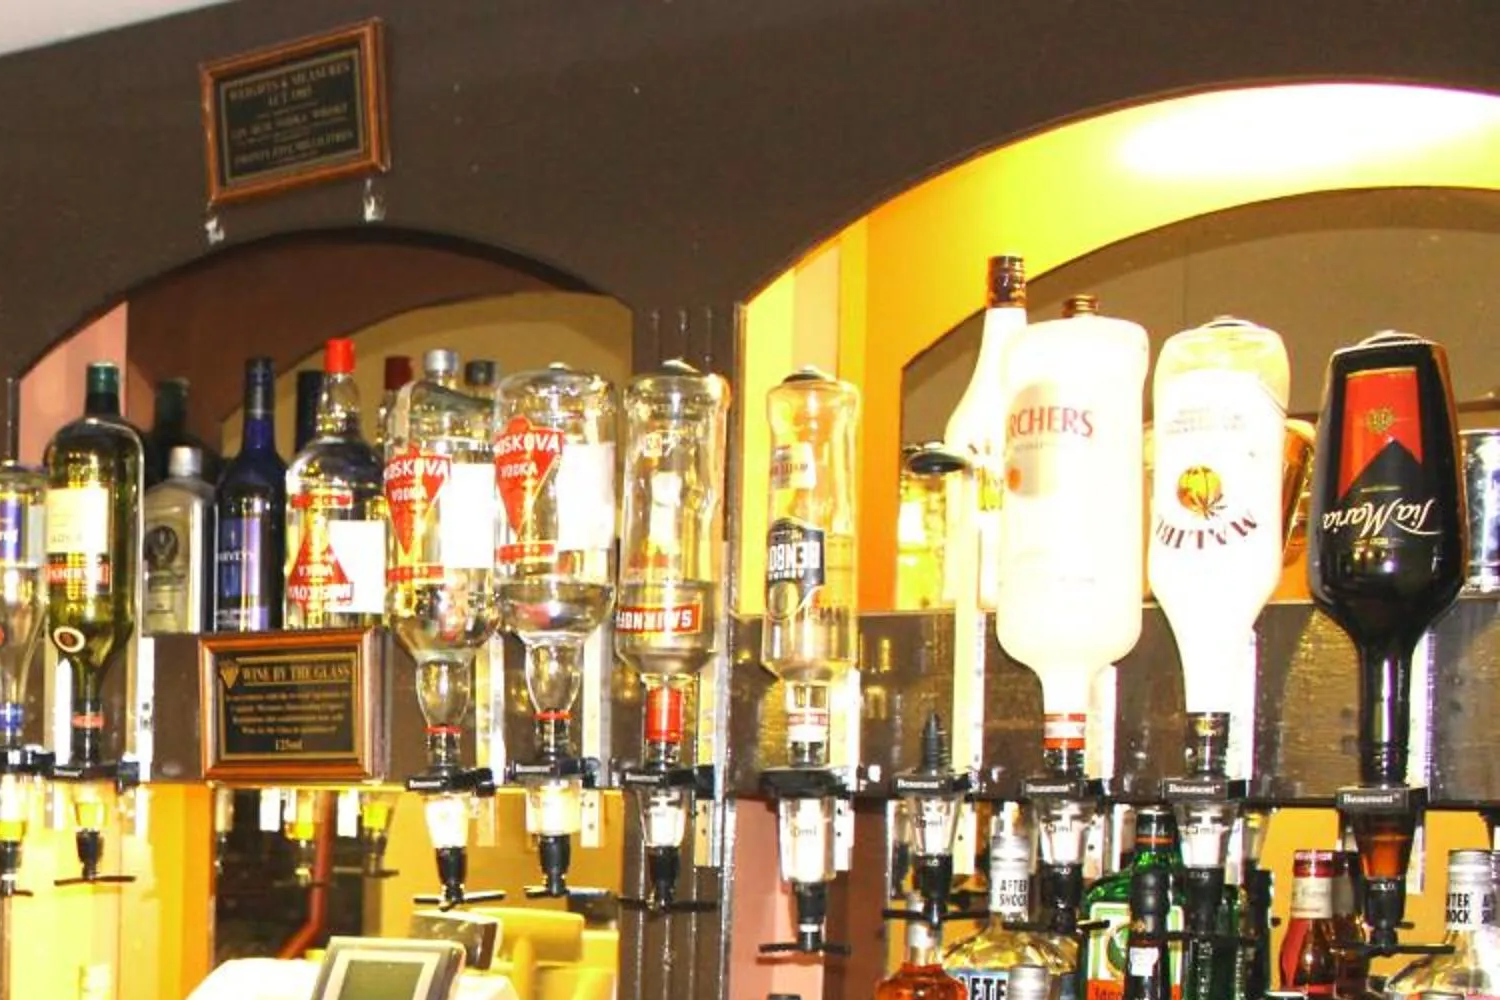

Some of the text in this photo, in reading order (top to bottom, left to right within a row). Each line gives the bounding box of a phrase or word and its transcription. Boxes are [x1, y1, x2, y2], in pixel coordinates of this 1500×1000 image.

[1009, 406, 1093, 438] RCHERS
[1322, 498, 1442, 538] Tia Maria
[769, 541, 821, 569] BENBO
[1446, 892, 1471, 908] TER
[1446, 908, 1471, 924] OCK
